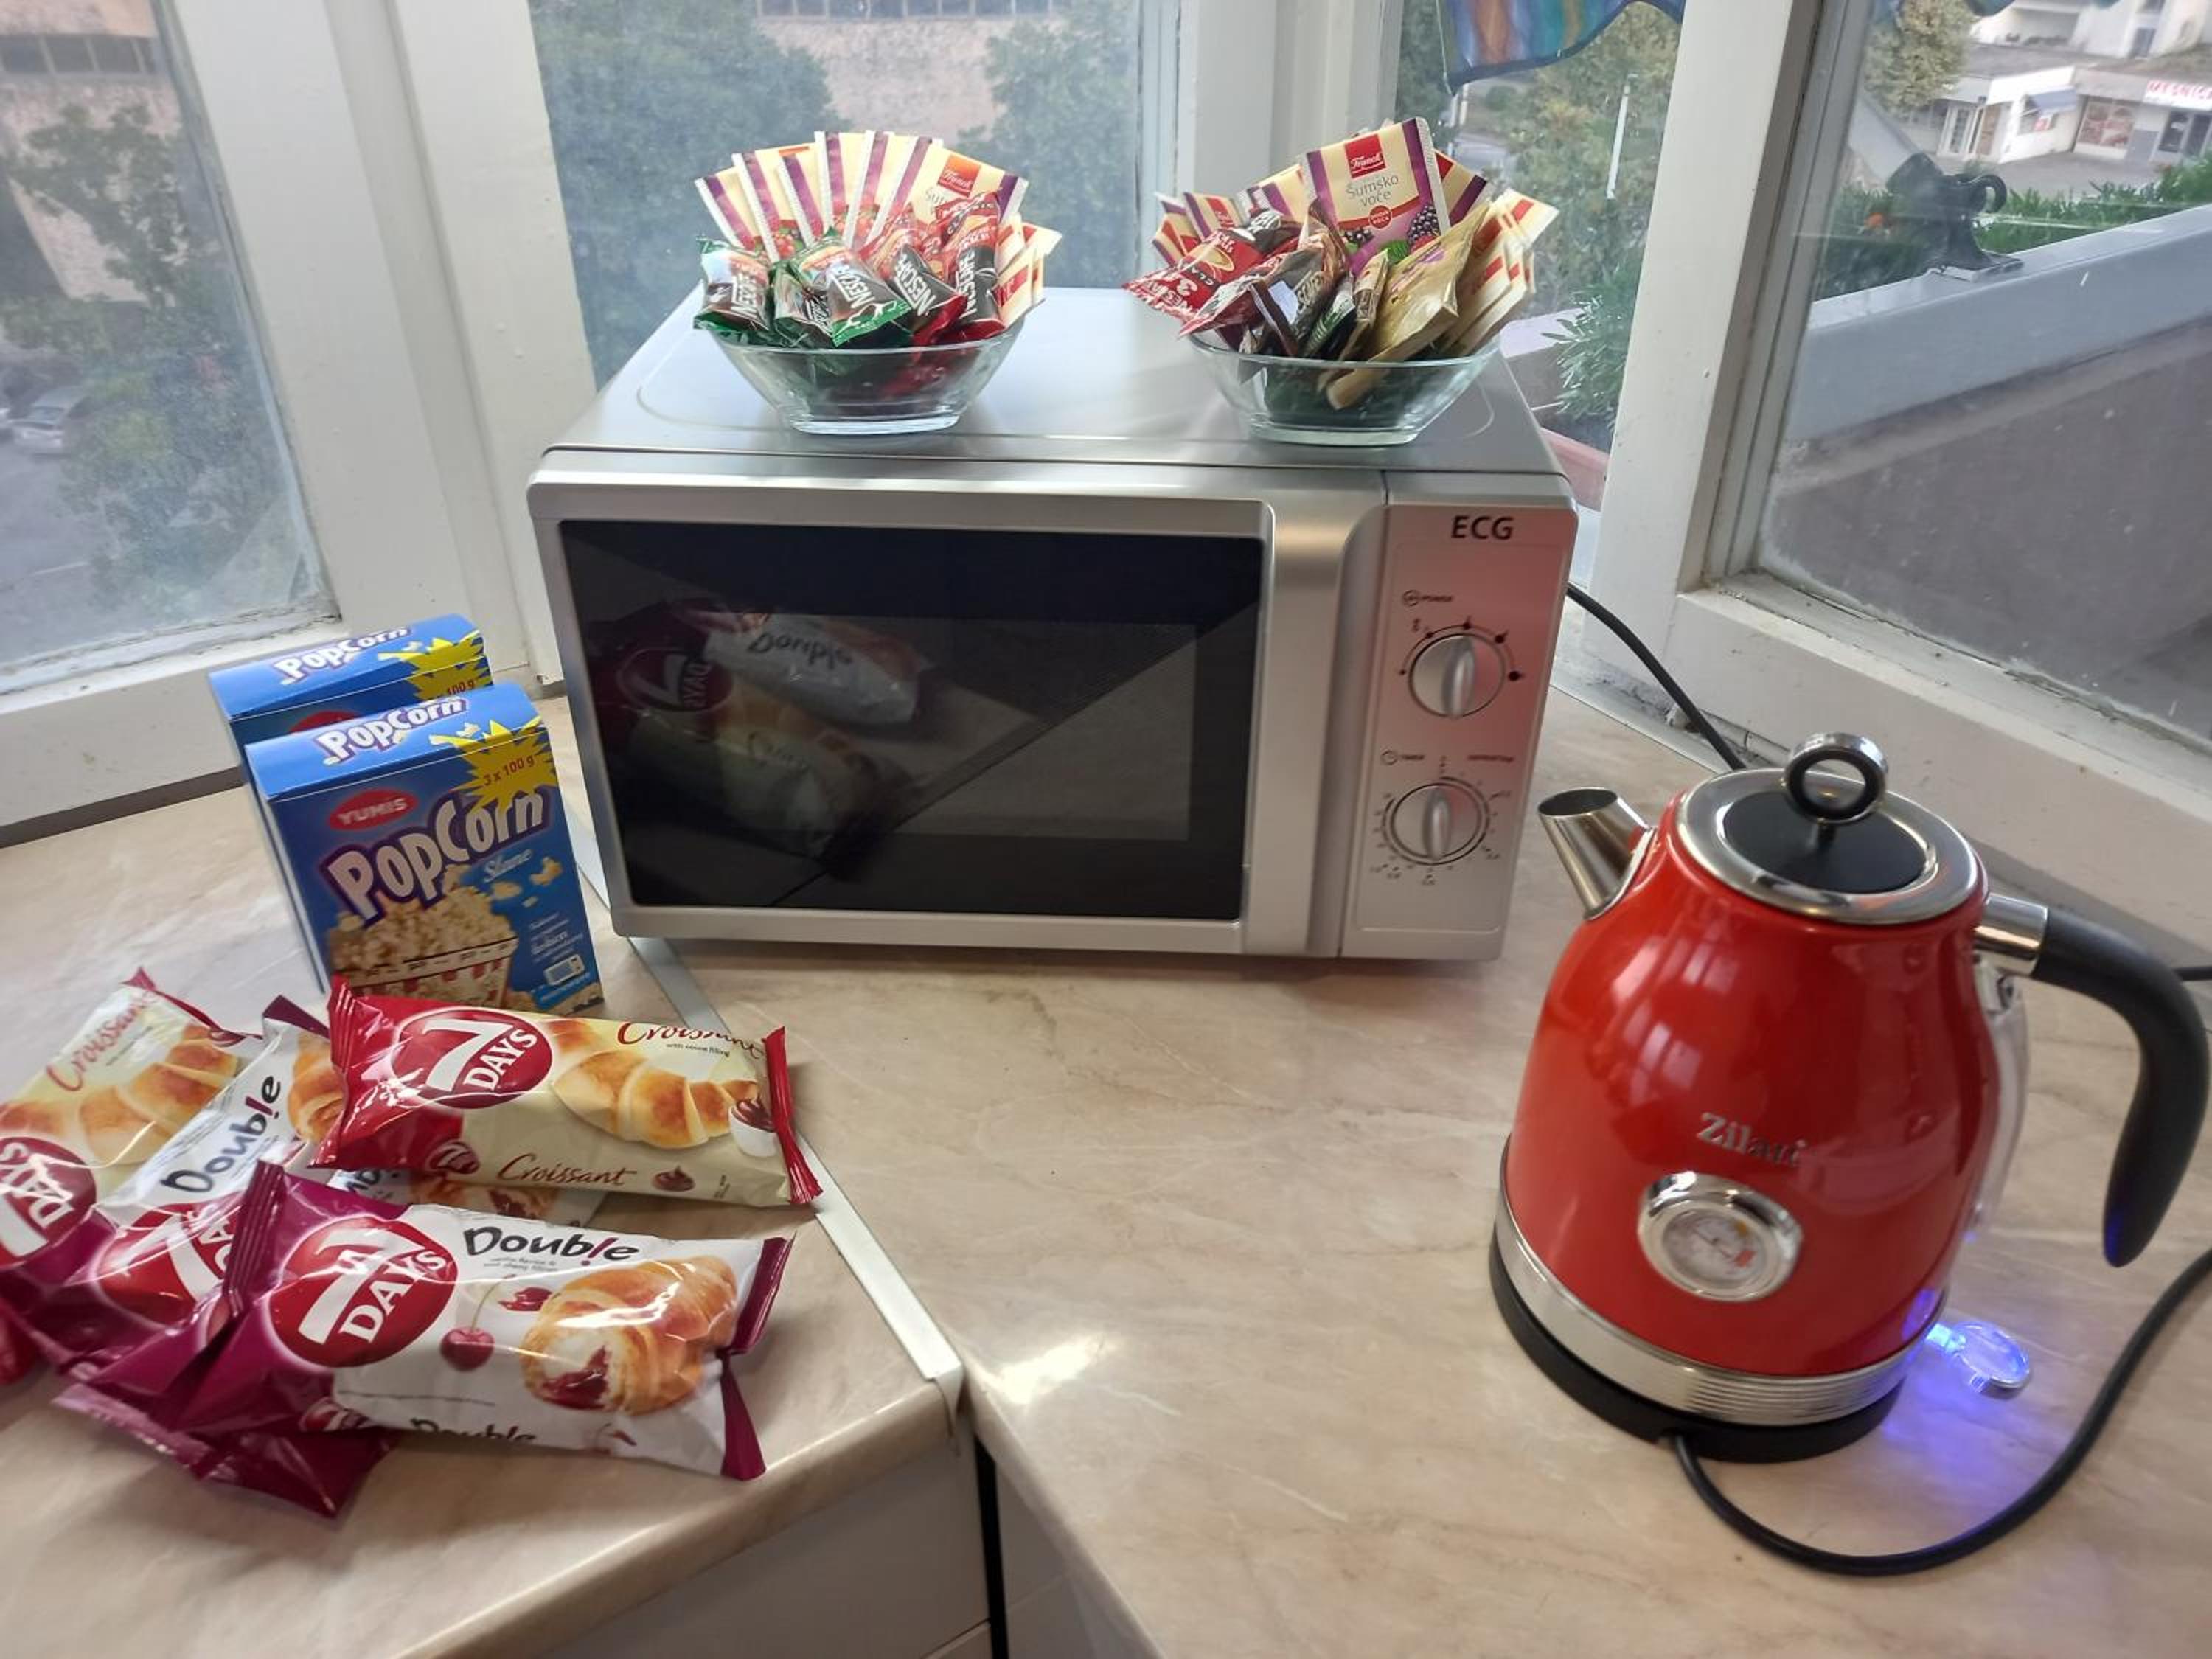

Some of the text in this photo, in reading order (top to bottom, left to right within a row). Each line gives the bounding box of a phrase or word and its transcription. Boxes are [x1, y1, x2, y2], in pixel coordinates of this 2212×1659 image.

[1346, 175, 1399, 200] Šumsko
[1451, 515, 1514, 540] ECG
[273, 626, 410, 686] PopCorn
[322, 698, 465, 765] PopCorn
[504, 757, 525, 776] 100
[526, 755, 535, 767] g
[337, 797, 408, 825] YUMIS
[327, 793, 543, 919] PopCorn
[415, 1019, 516, 1092] 7
[463, 1029, 538, 1090] DAYS
[161, 1074, 282, 1193] Double
[498, 1152, 638, 1186] Croissant
[463, 1226, 640, 1267] Double
[299, 1227, 428, 1344] 7
[340, 1249, 448, 1343] DAYS
